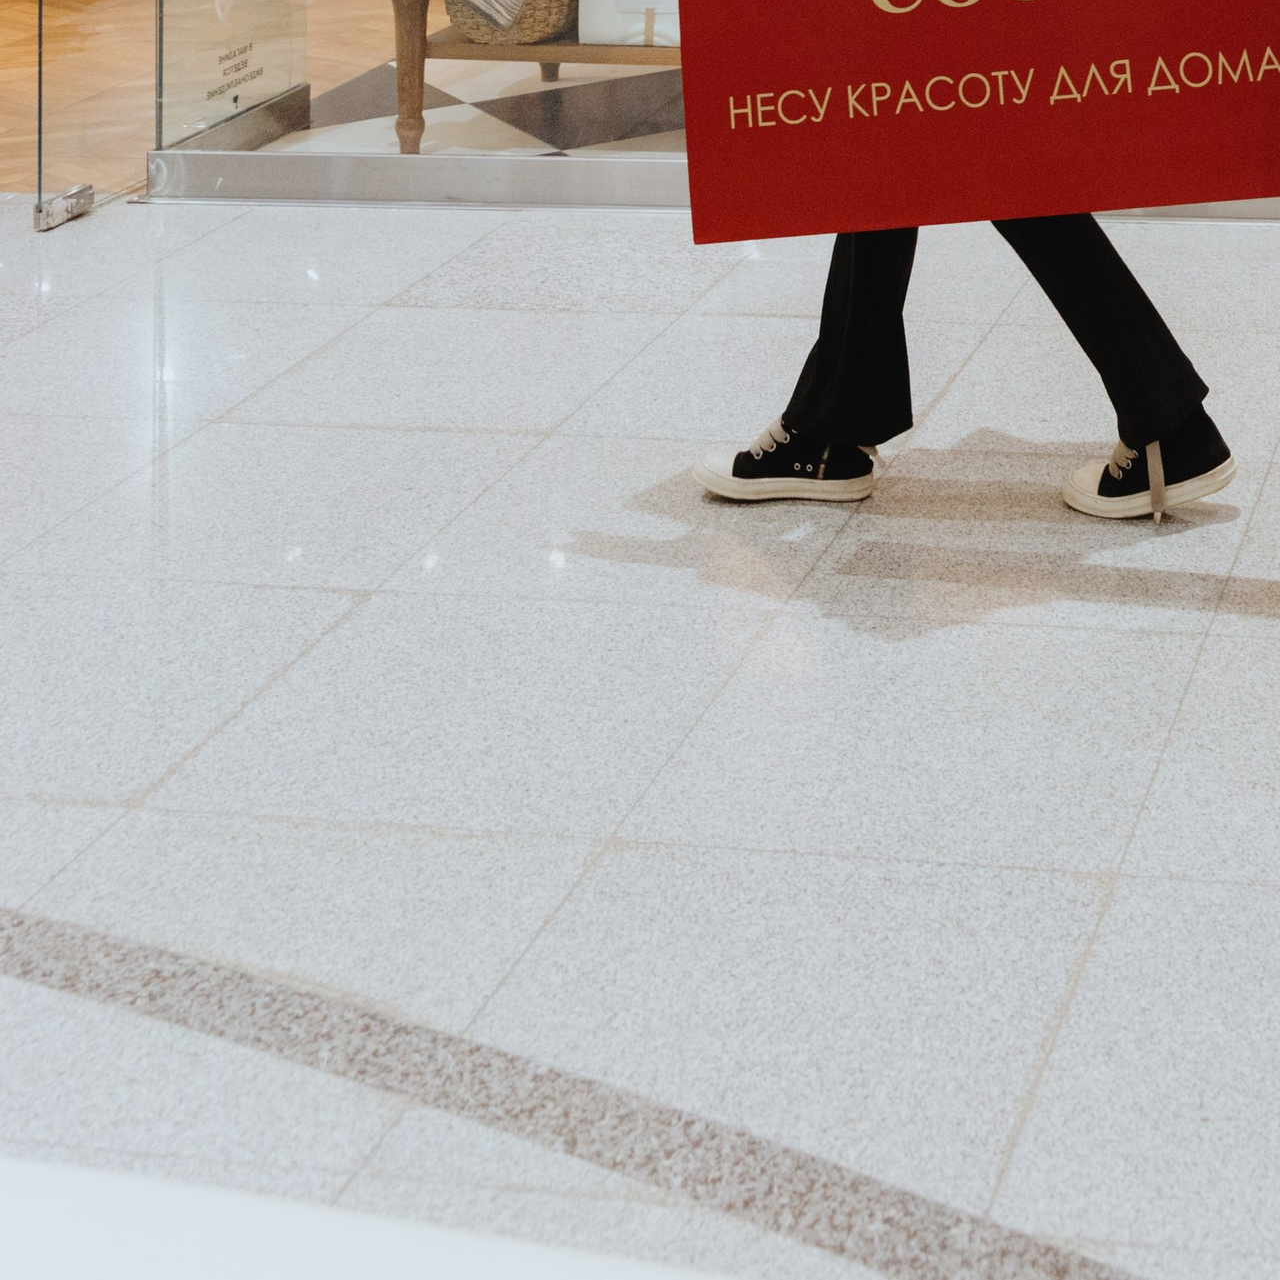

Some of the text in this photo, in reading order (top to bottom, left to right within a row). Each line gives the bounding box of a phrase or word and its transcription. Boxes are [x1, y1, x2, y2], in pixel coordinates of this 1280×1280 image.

[730, 88, 832, 130] НЕСУ
[848, 69, 1035, 119] КРАСОТУ
[1050, 60, 1133, 105] ДЛЯ
